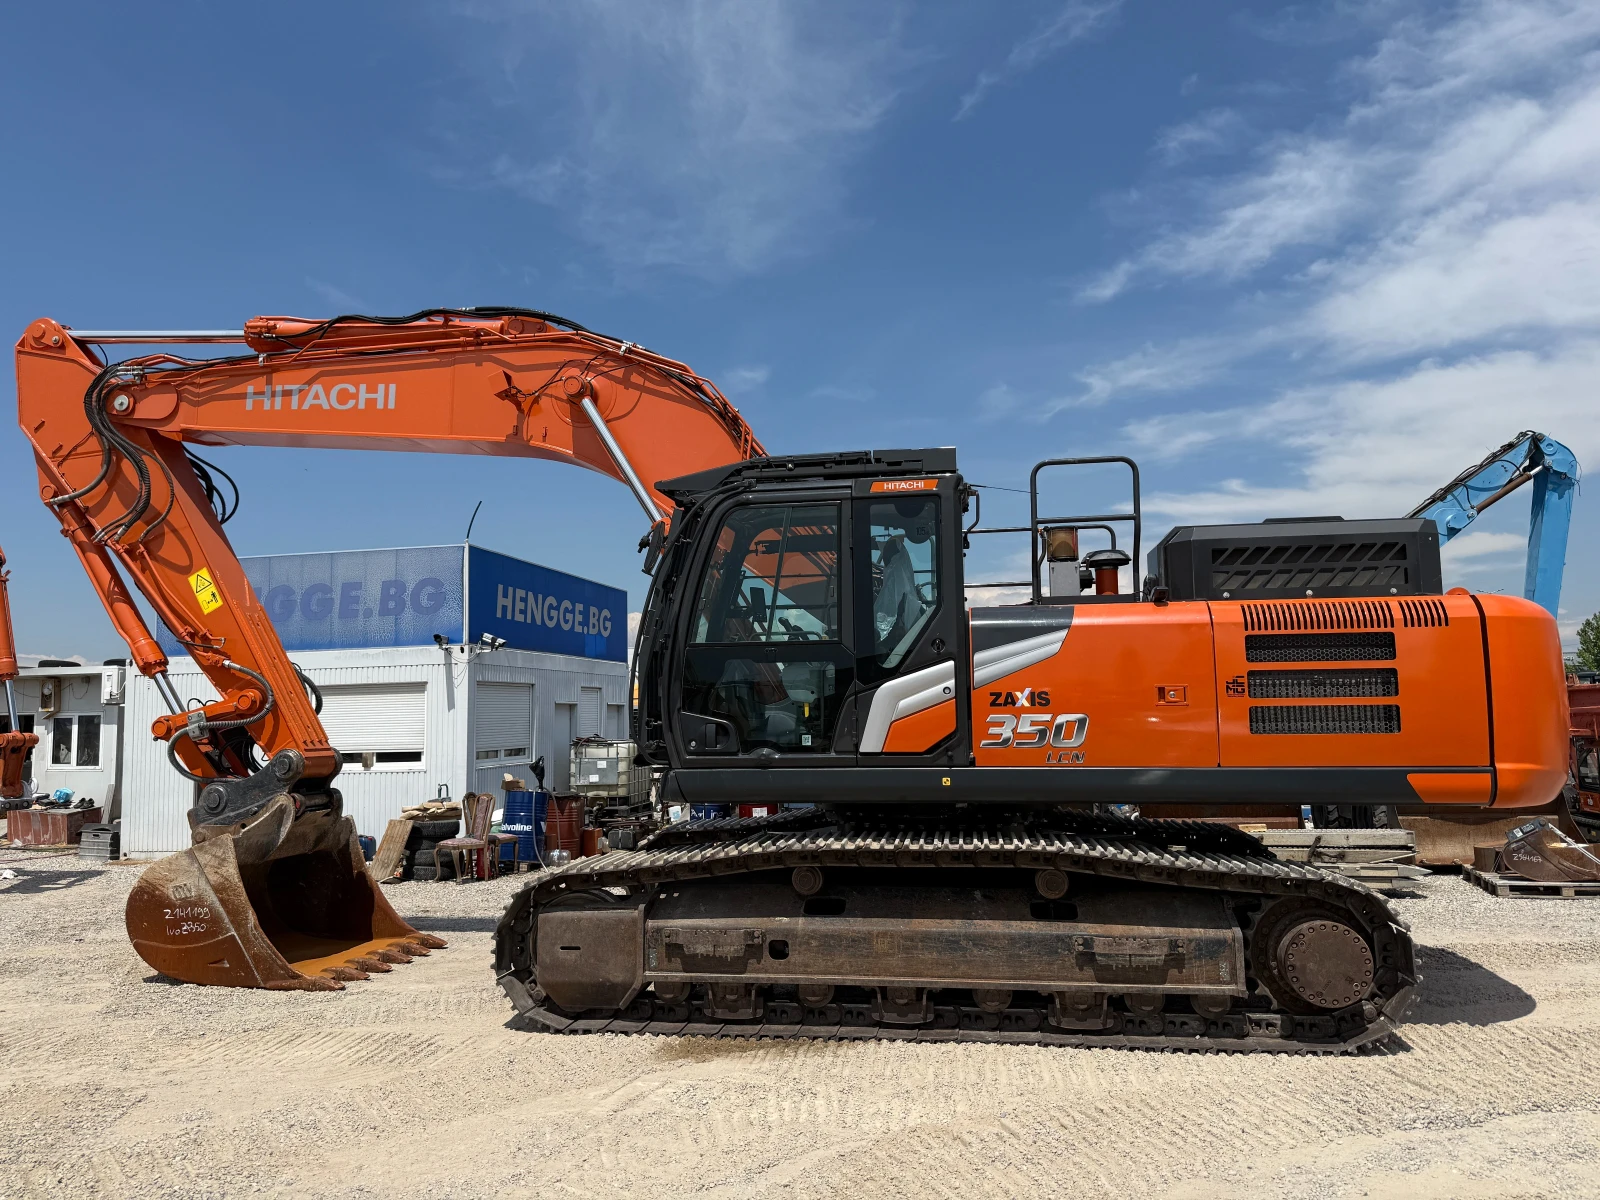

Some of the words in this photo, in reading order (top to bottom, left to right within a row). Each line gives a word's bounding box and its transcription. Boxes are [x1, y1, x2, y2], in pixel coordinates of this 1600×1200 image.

[245, 383, 397, 410] HITACHI
[883, 481, 924, 490] HITACHI
[496, 583, 612, 637] HENGGE.BG
[989, 687, 1051, 707] ZAXIS
[979, 713, 1090, 748] 350
[1045, 751, 1085, 764] LCN
[501, 823, 532, 832] alvoline
